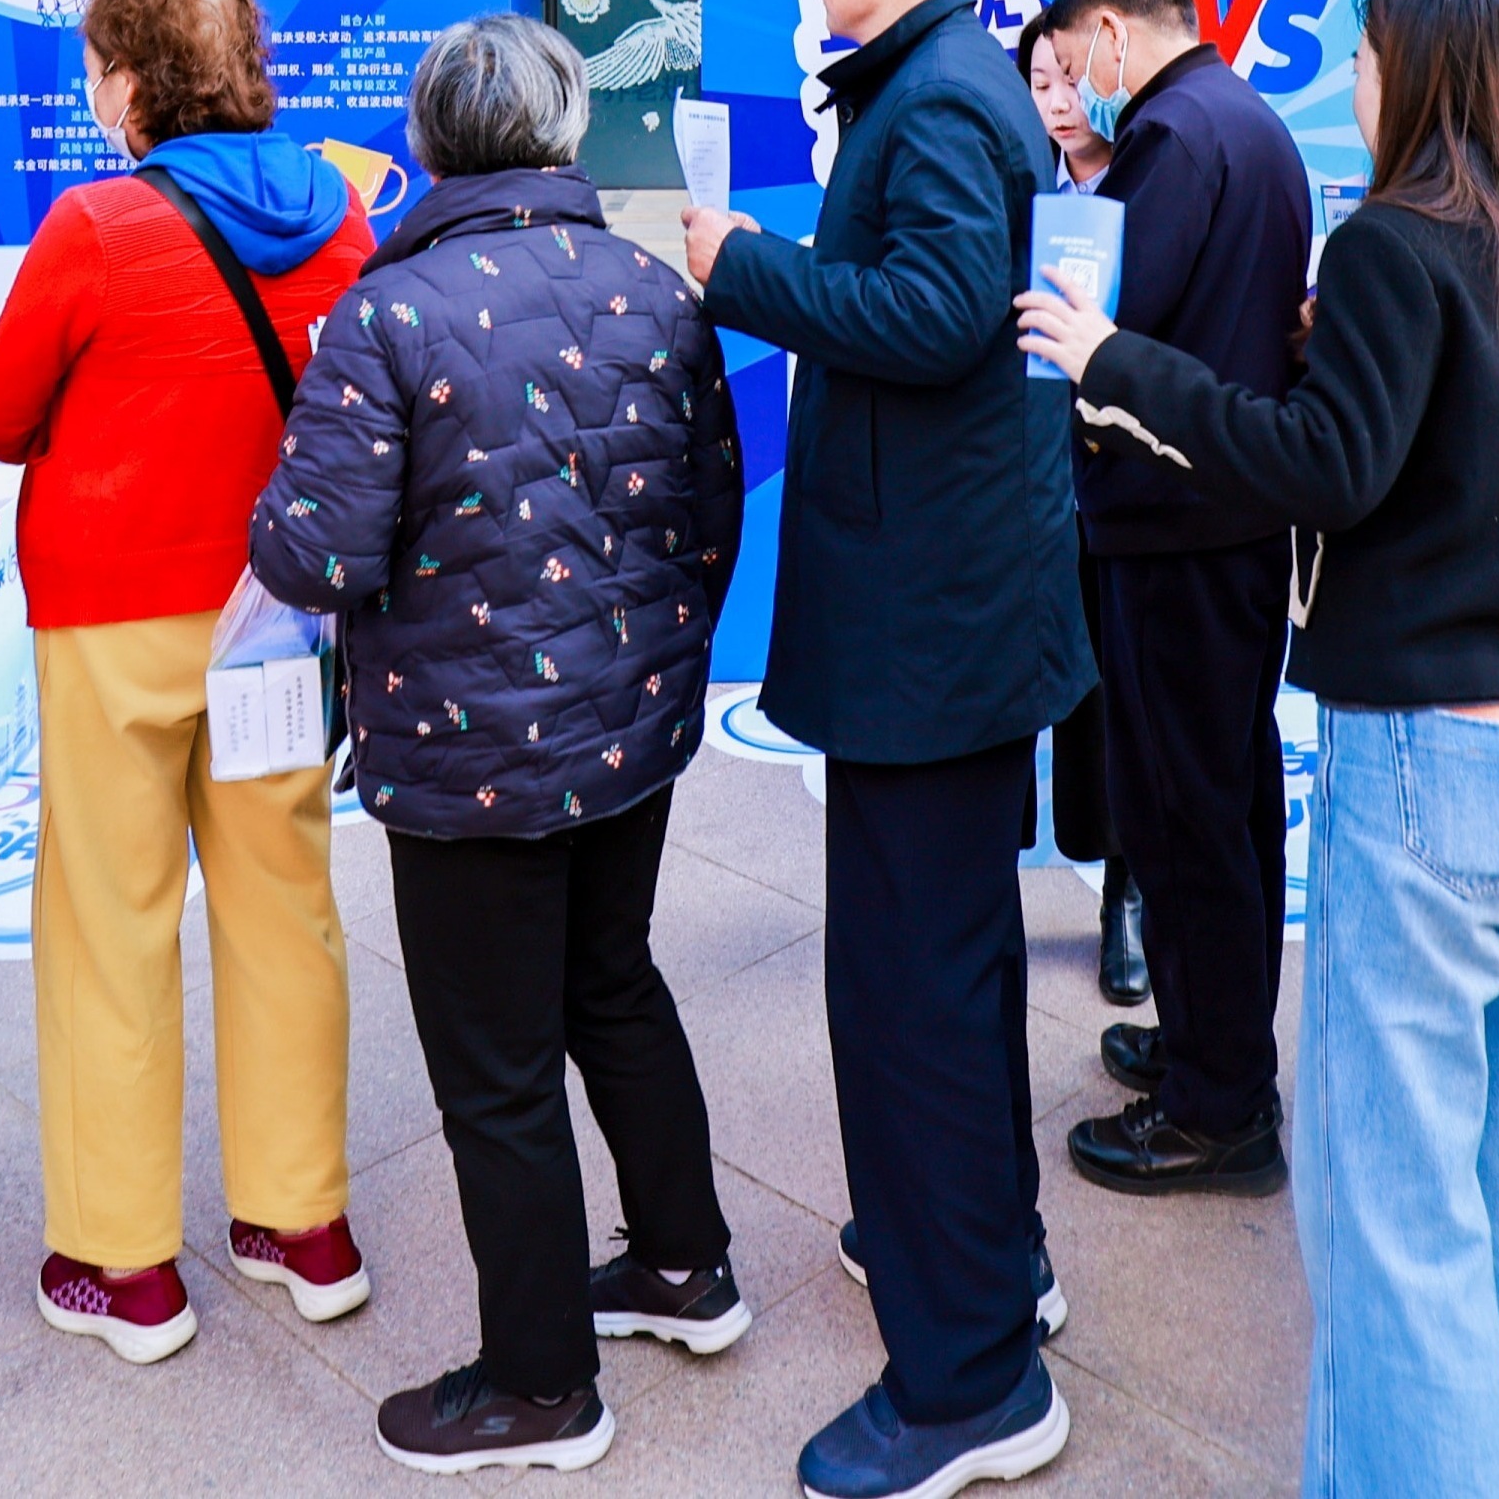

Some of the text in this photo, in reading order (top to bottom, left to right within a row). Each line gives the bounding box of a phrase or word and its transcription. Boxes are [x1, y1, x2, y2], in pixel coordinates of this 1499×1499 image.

[340, 14, 386, 27] 适合人群
[340, 47, 386, 59] 适配产品
[329, 79, 398, 92] 风险等级定义
